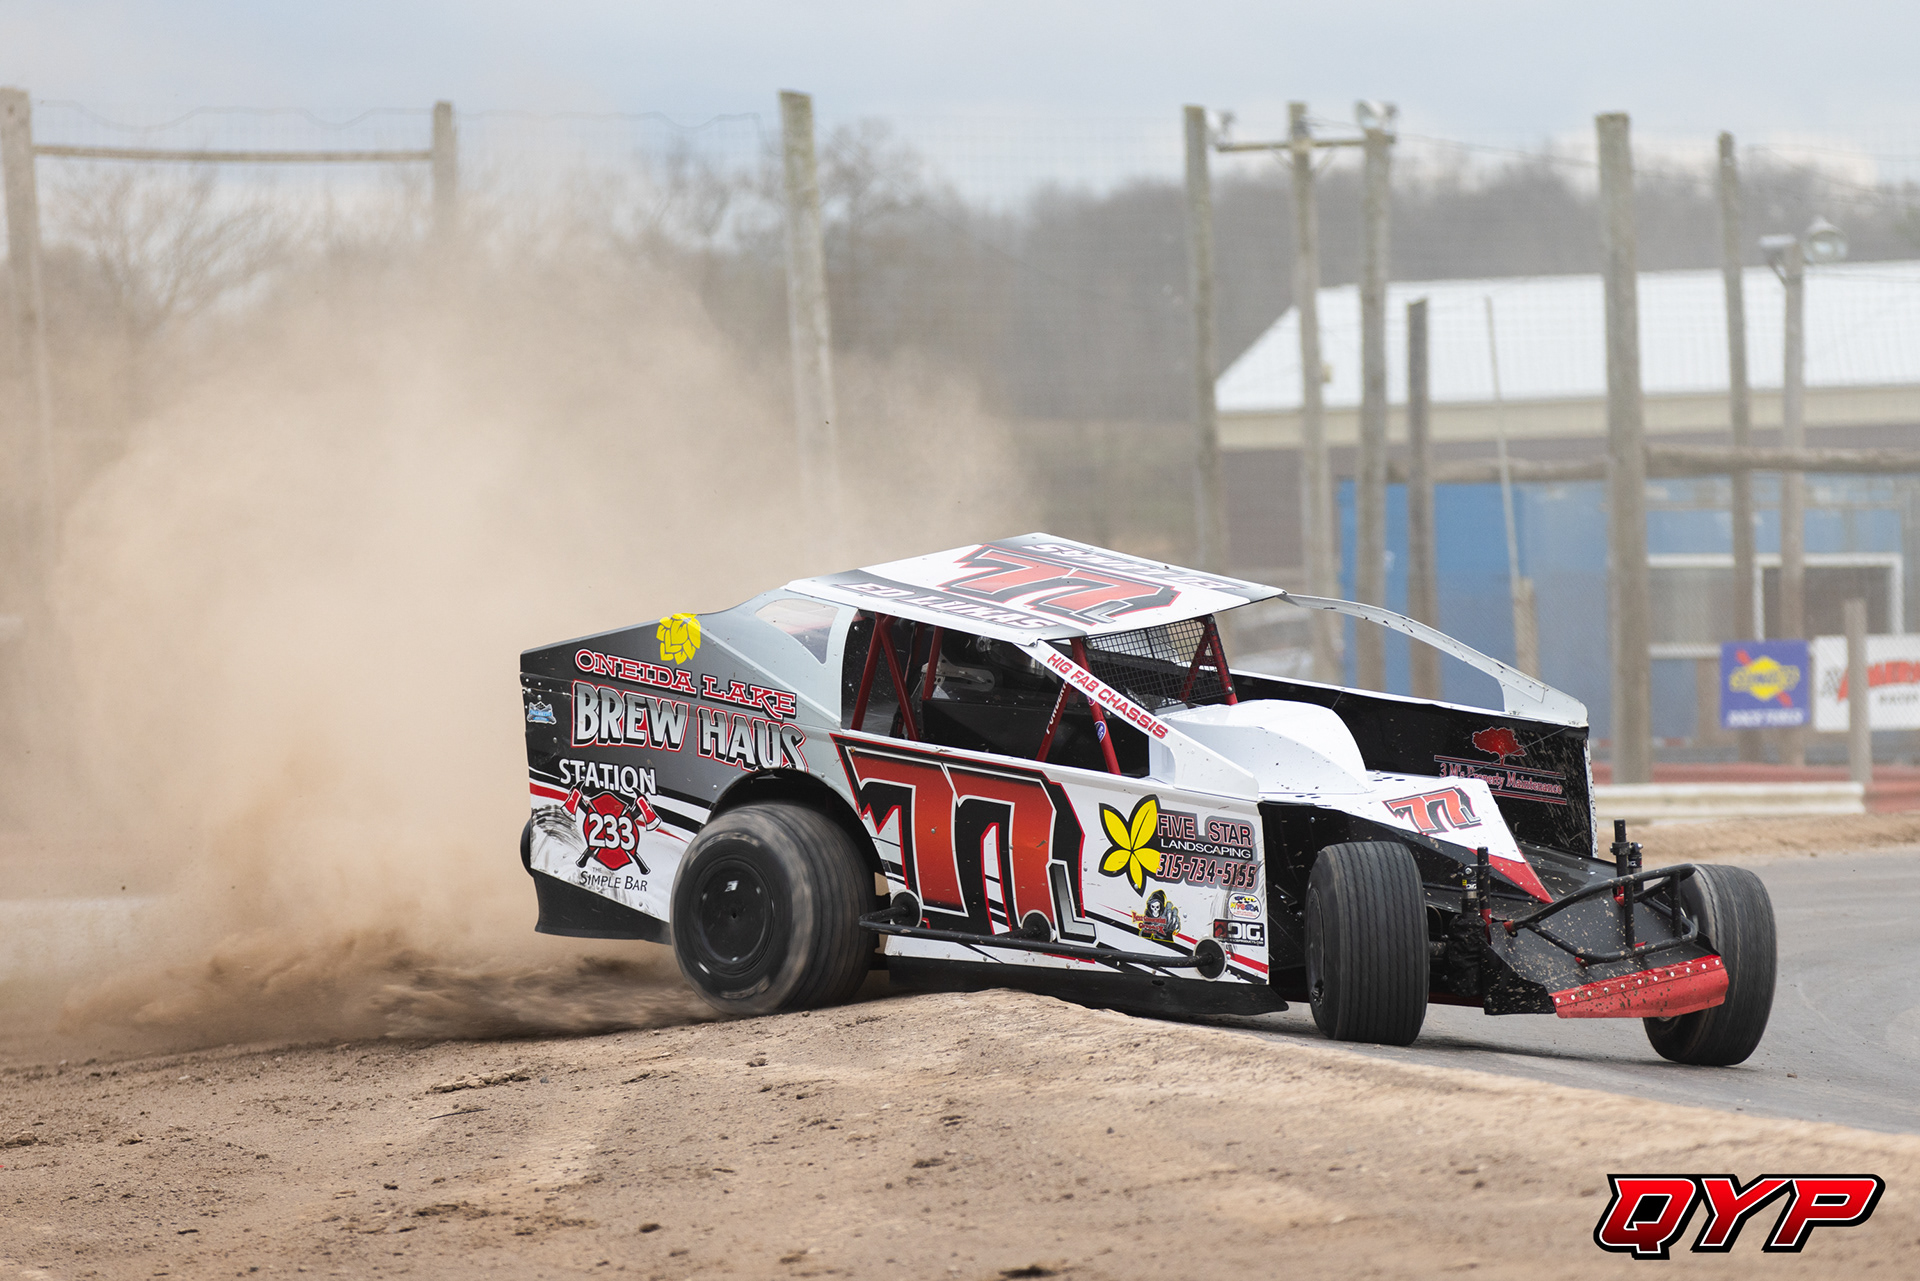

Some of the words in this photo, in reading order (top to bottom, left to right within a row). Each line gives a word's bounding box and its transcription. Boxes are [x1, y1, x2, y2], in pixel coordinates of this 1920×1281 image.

[838, 582, 916, 598] ED
[913, 596, 1058, 629] LUKAS
[574, 648, 697, 695] ONEIDA
[702, 675, 797, 720] LAKE
[1047, 653, 1073, 675] HIG
[1070, 670, 1099, 693] FAB
[1098, 688, 1168, 739] CHASSIS
[571, 680, 690, 752] BREW
[696, 706, 809, 772] HAUS
[559, 758, 657, 795] STATION
[1439, 763, 1447, 778] 3
[1506, 770, 1563, 795] Maintenance
[588, 812, 636, 851] 233
[1157, 813, 1196, 840] FIVE
[1208, 819, 1253, 847] STAR
[1161, 839, 1252, 859] LANDSCAPING
[624, 875, 648, 892] BAR
[1156, 852, 1257, 889] 315-734-5155
